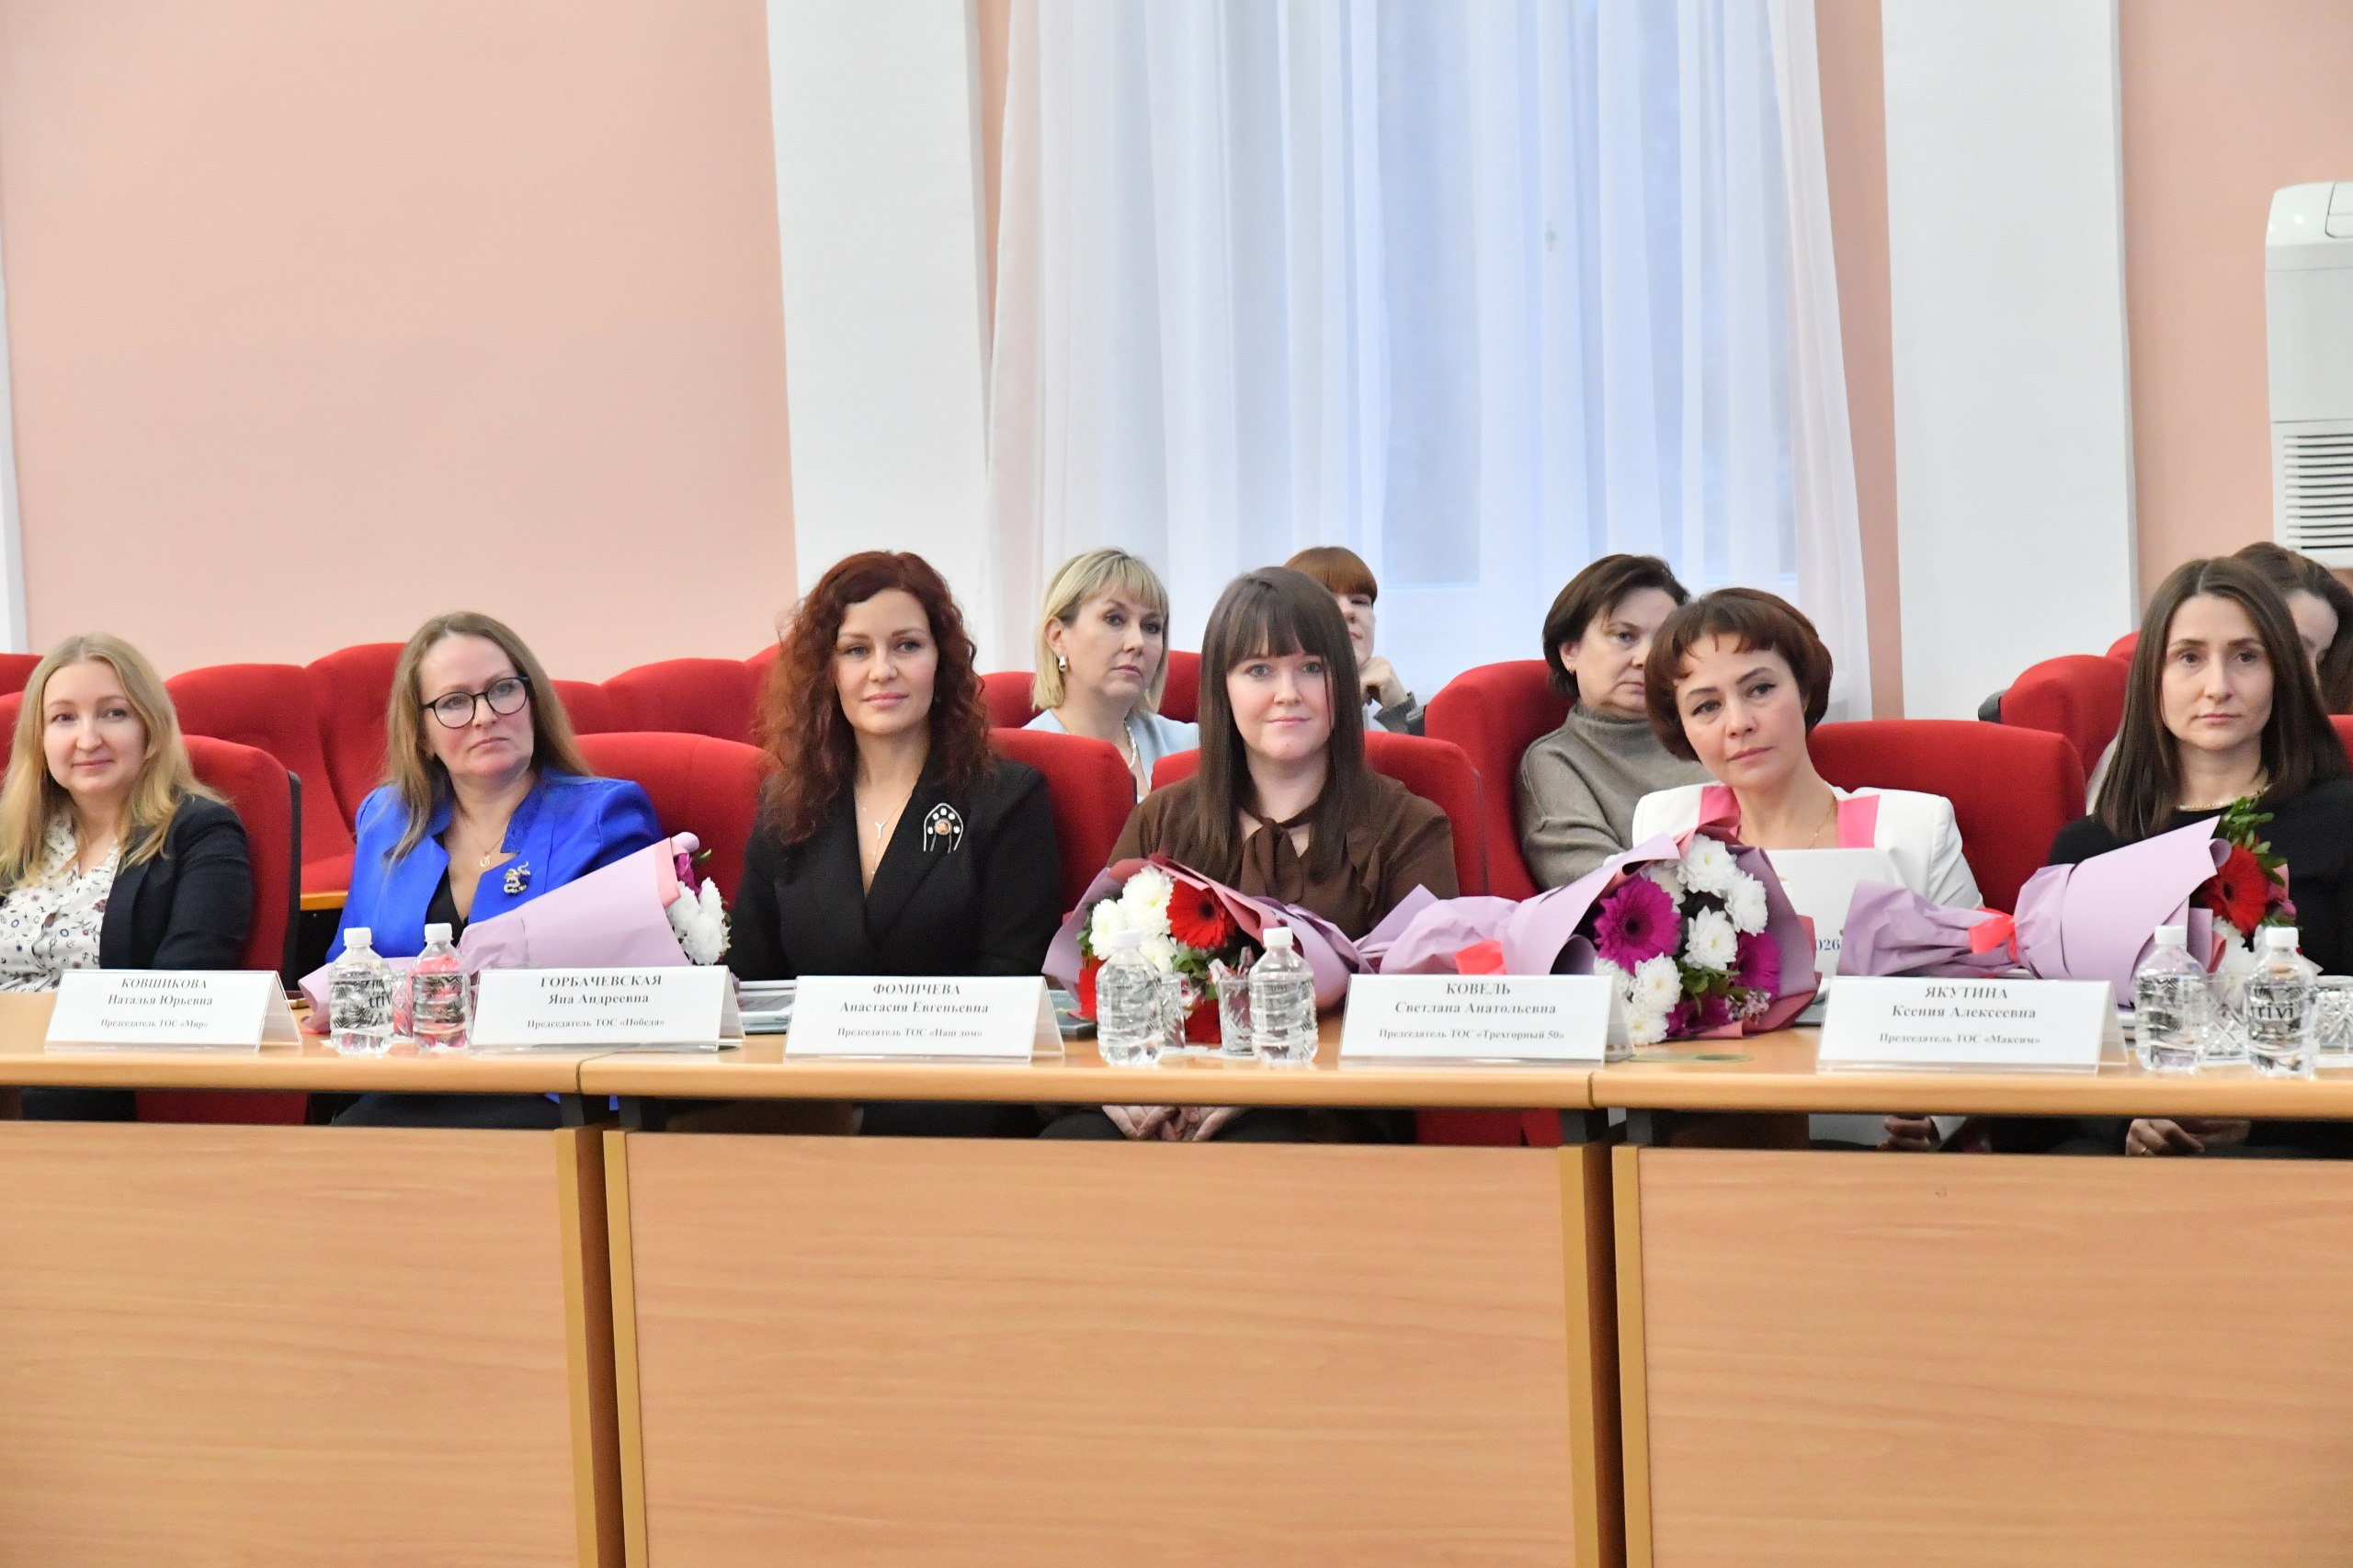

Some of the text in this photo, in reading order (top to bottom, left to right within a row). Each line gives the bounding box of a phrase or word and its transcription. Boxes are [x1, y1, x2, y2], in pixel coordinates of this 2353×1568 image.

[540, 975, 662, 988] ГОРБАЧЕВСКАЯ
[872, 983, 961, 995] ФОМИЧЕВА
[1446, 983, 1511, 995] КОВЕЛЬ
[1925, 986, 2008, 999] ЯКУТИНА
[108, 994, 213, 1008] Наталья Юрьевна
[548, 994, 649, 1006] Яна Андреевна
[839, 1002, 989, 1014] Анастасия Евгеньевна
[1395, 1001, 1556, 1015] Светлана Анатольевна
[1892, 1005, 2036, 1019] Ксения Алексеевна
[100, 1018, 155, 1028] Председатель
[160, 1019, 178, 1028] ТОС
[527, 1019, 591, 1028] Председатель
[597, 1018, 617, 1027] ТОС
[837, 1028, 901, 1037] Председатель
[905, 1028, 926, 1037] ТОС
[1379, 1028, 1446, 1039] Председатель
[1450, 1029, 1472, 1038] ТОС
[1880, 1033, 1952, 1044] Председатель
[1957, 1034, 1981, 1043] ТОС
